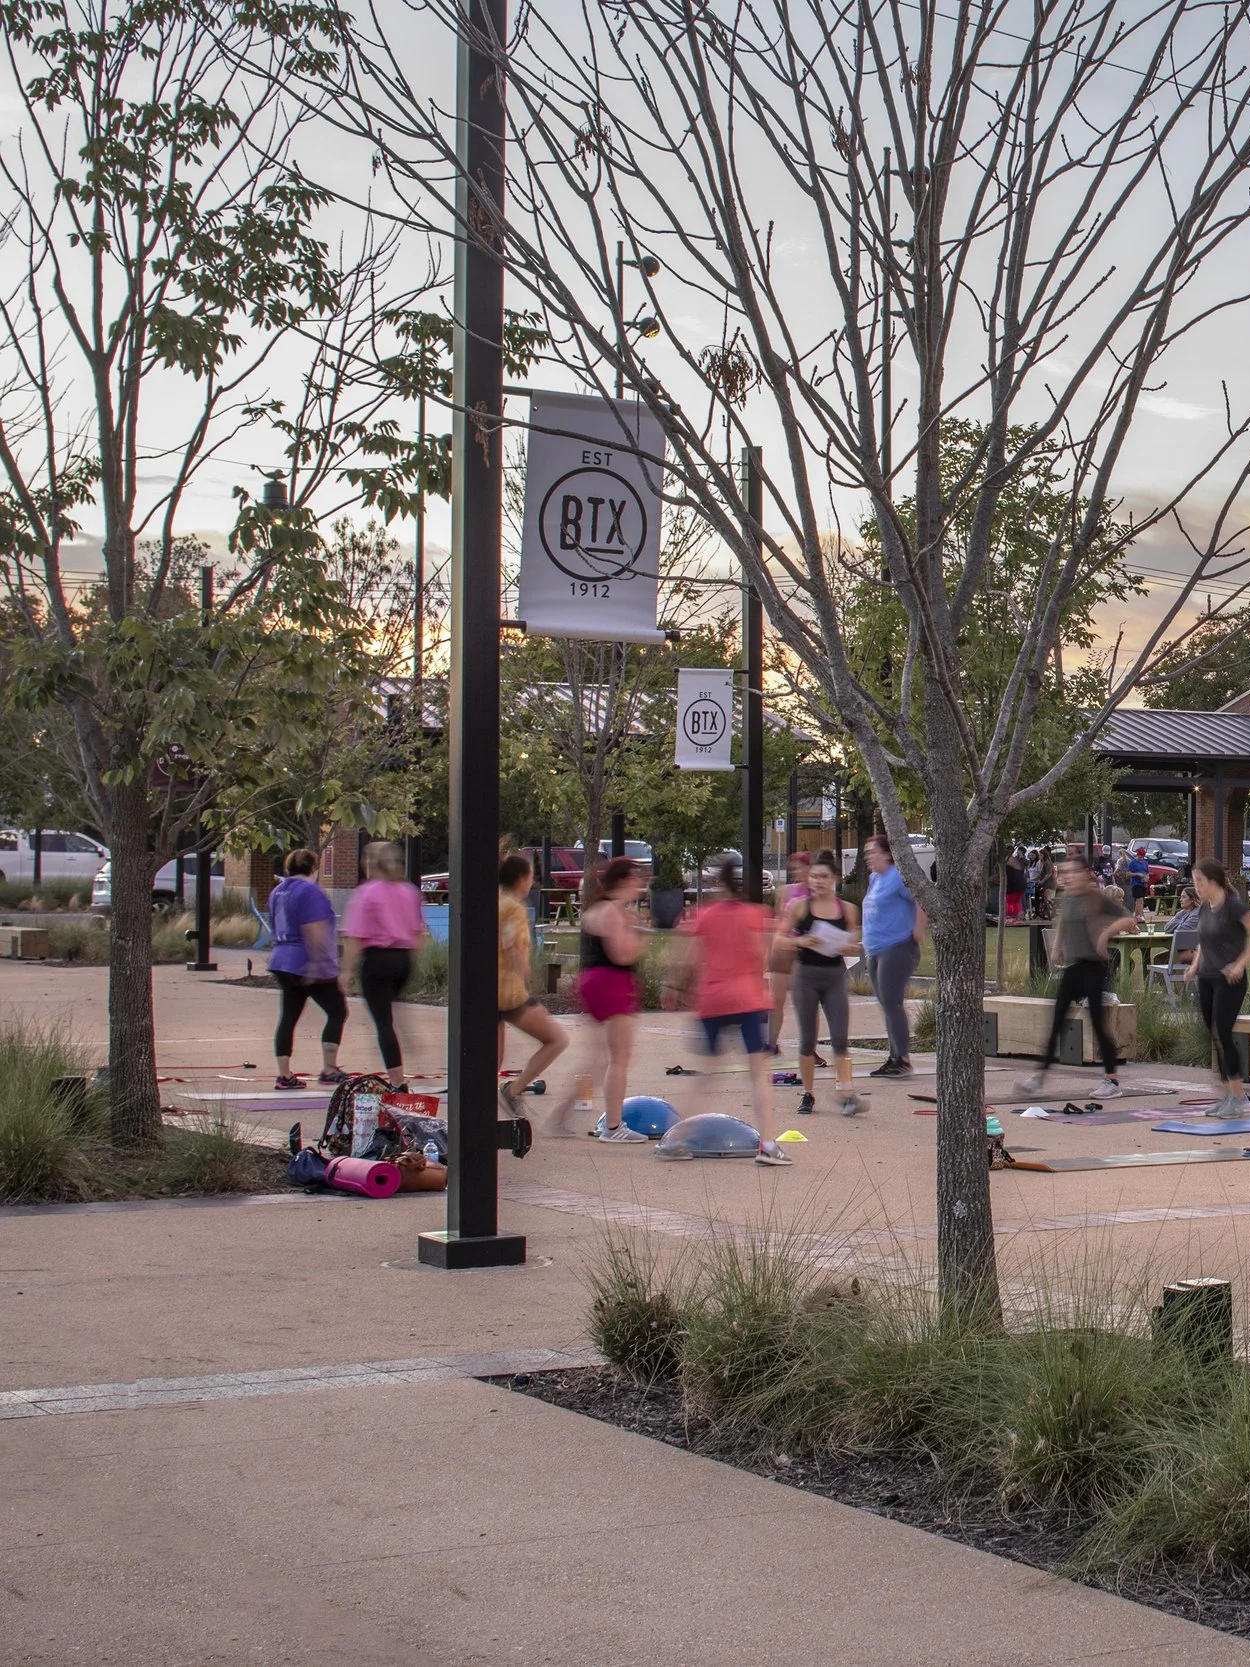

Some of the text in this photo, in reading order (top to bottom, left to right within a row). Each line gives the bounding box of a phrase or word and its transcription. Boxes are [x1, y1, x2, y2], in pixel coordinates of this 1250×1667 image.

[581, 450, 613, 466] EST
[560, 494, 627, 551] BTX
[570, 582, 610, 598] 1912
[698, 691, 712, 699] EST
[691, 711, 718, 735] BTX
